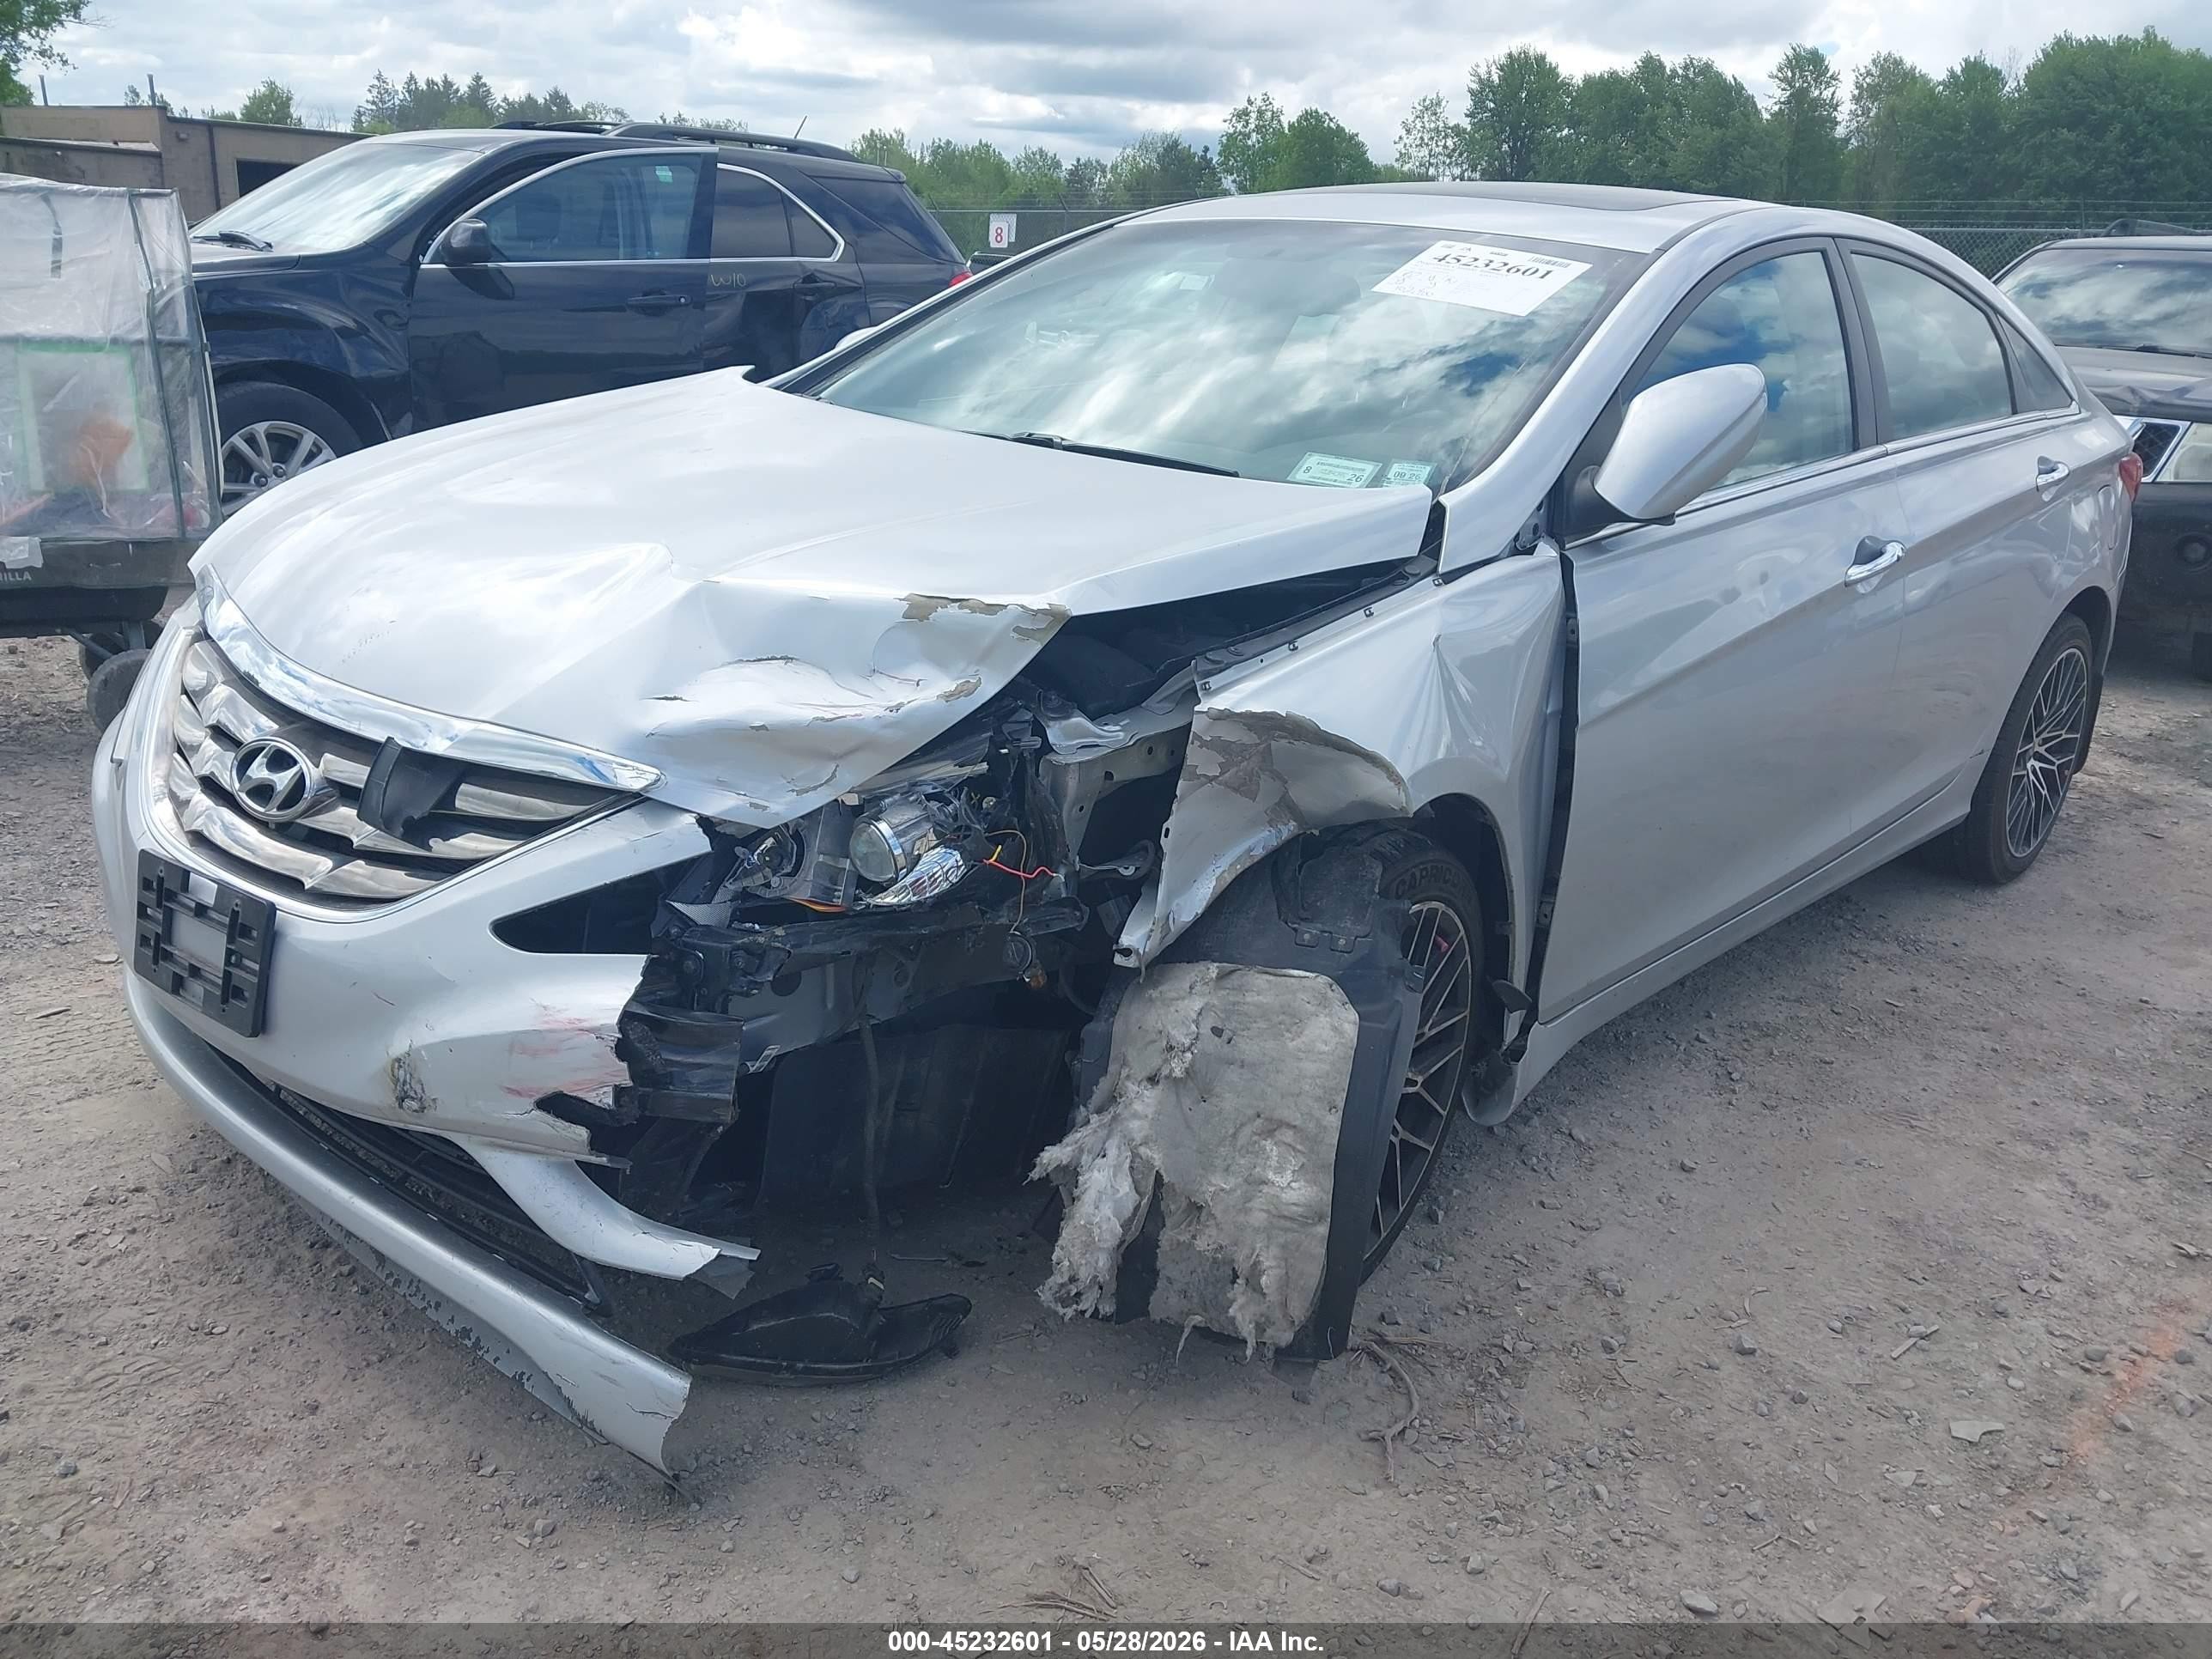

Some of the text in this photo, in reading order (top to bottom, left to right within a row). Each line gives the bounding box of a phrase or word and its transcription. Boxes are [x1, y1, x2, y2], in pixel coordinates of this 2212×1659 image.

[994, 226, 1003, 244] 8
[1432, 252, 1554, 280] 45232601
[1303, 465, 1313, 474] 8
[1346, 473, 1364, 483] 26
